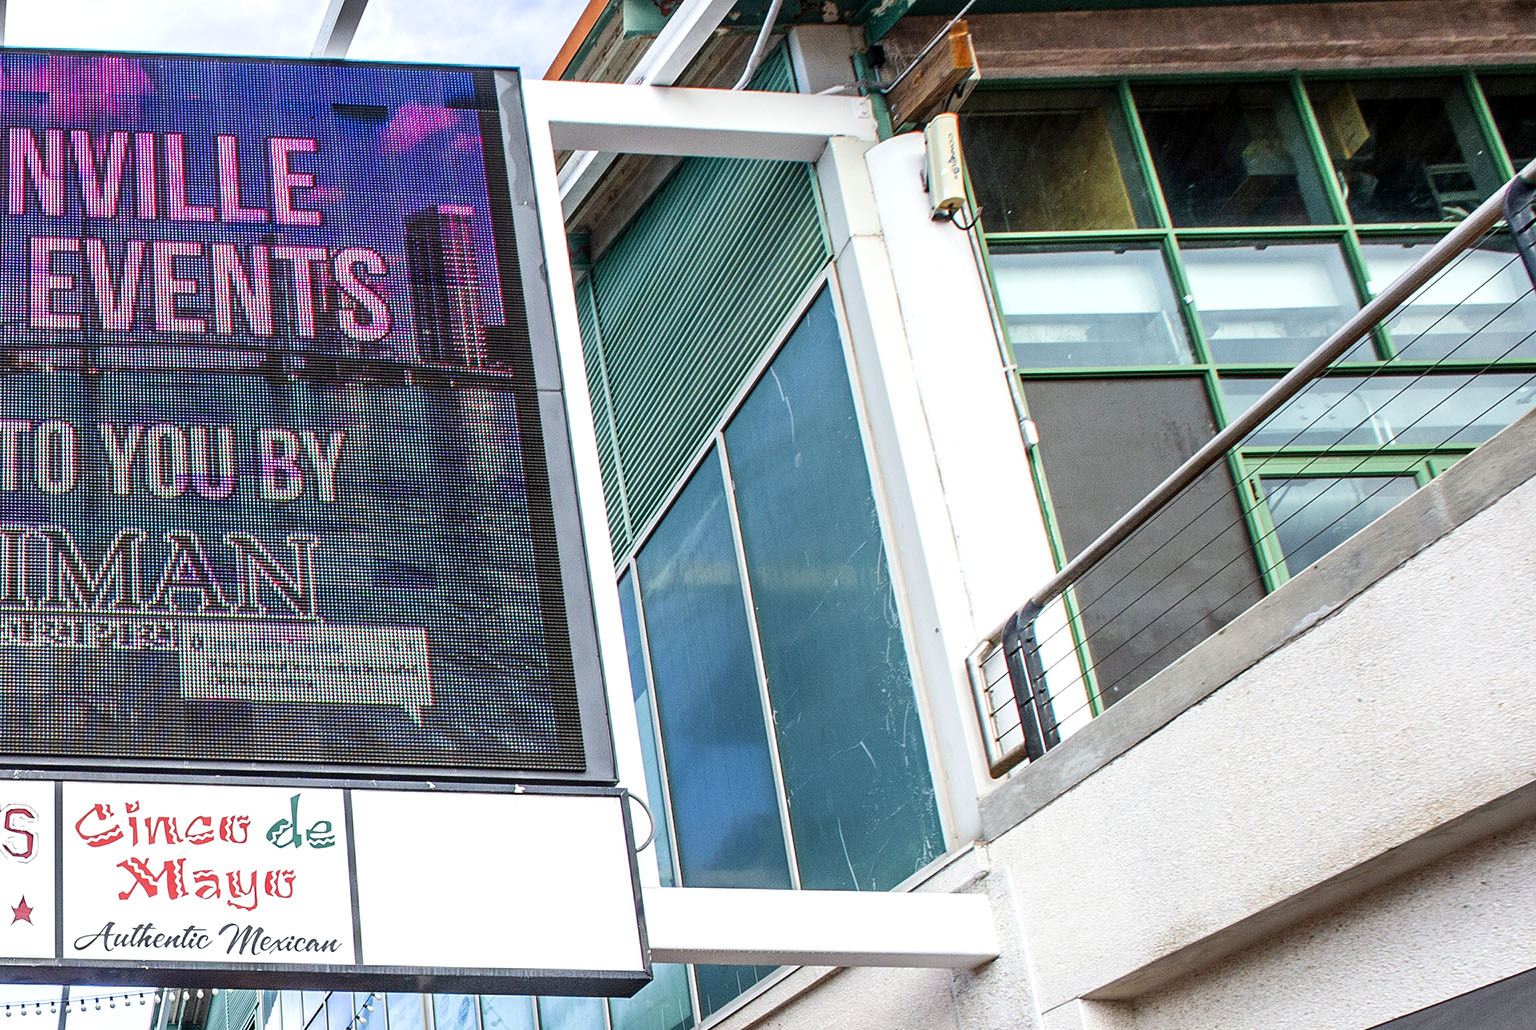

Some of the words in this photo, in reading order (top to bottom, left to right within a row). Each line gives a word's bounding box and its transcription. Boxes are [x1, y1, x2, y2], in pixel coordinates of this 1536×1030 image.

[30, 236, 390, 341] EVENTS
[98, 422, 234, 500] YOU
[257, 427, 346, 501] BY
[75, 801, 252, 848] Cinco
[266, 793, 336, 849] de
[116, 857, 297, 911] Mayo
[73, 921, 213, 952] Authentic
[218, 923, 343, 955] Mexican
